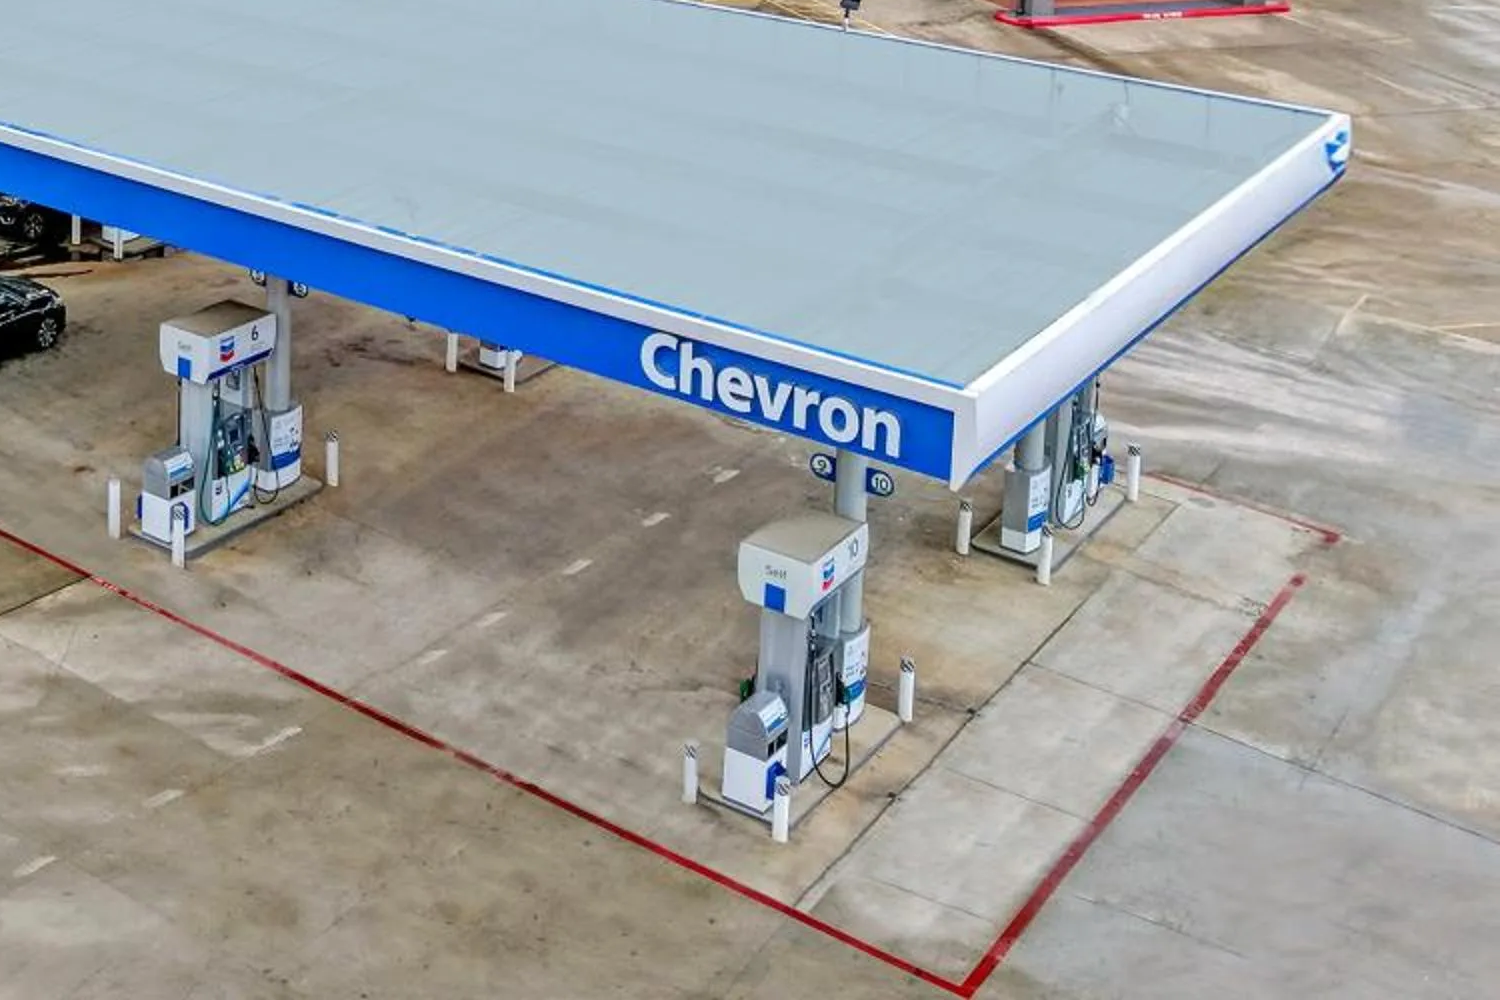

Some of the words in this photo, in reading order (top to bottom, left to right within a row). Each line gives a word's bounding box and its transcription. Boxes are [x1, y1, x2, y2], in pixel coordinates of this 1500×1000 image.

[251, 325, 259, 341] 6
[640, 332, 901, 459] Chevron
[874, 477, 889, 491] 10
